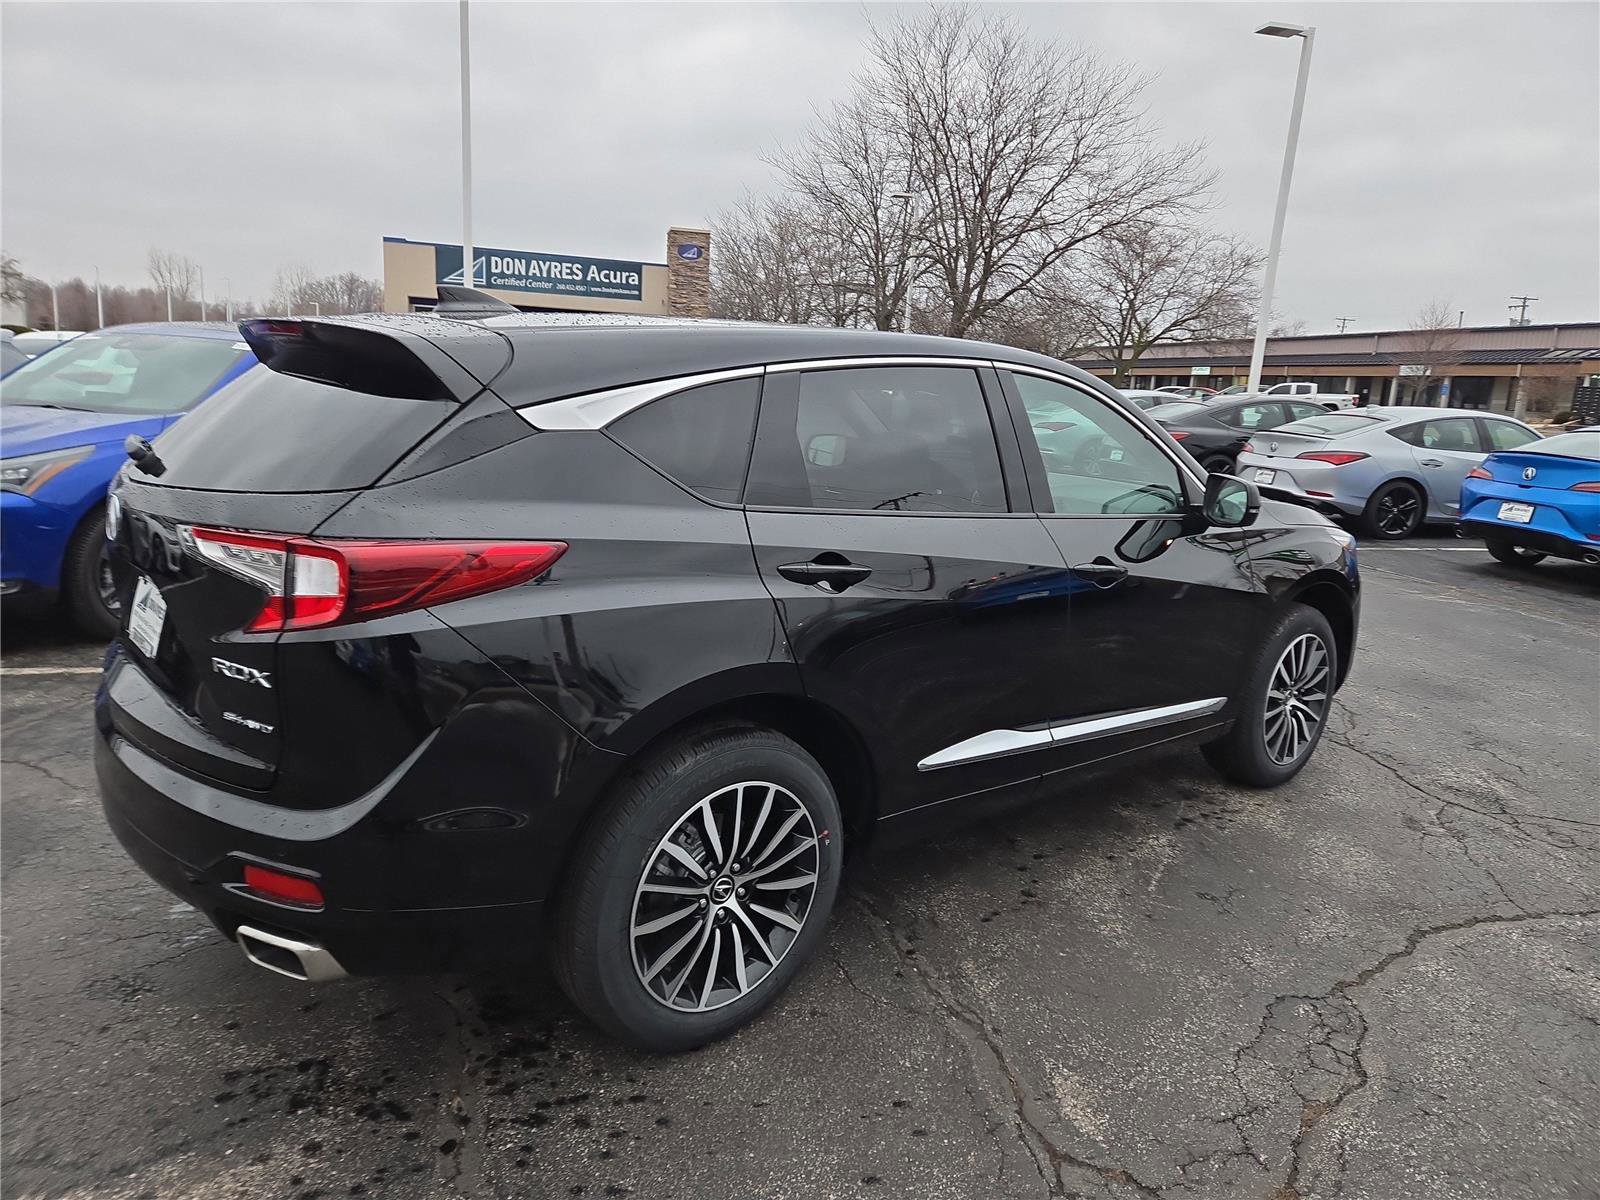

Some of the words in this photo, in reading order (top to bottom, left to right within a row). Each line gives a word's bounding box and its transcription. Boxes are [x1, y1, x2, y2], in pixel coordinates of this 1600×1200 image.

[491, 256, 526, 276] DON
[528, 260, 583, 281] AYRES
[586, 265, 639, 285] Acura
[491, 276, 526, 287] Certified
[526, 279, 553, 289] Center
[211, 657, 272, 689] RDX
